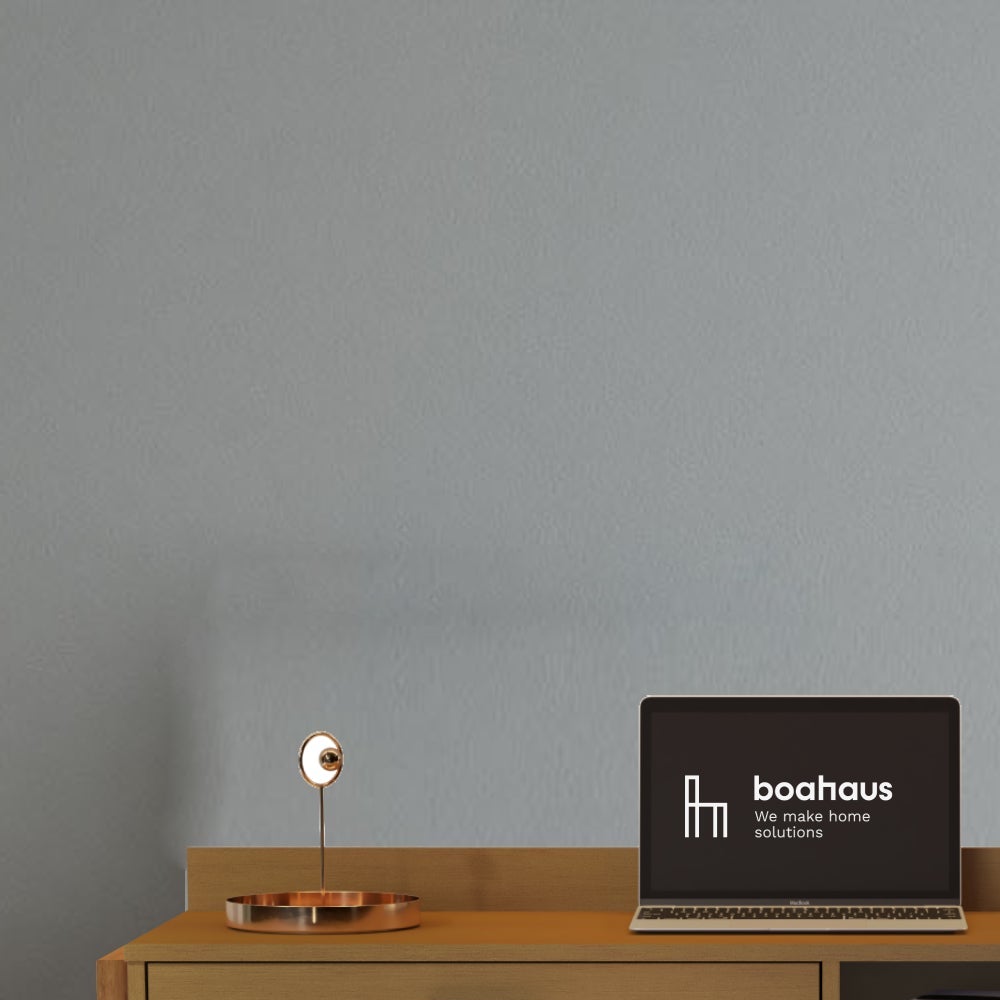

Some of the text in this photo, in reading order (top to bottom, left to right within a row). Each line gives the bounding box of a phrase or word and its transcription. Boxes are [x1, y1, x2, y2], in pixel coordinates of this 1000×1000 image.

[753, 774, 893, 802] boahaus
[754, 809, 871, 823] We make home
[754, 825, 824, 839] solutions
